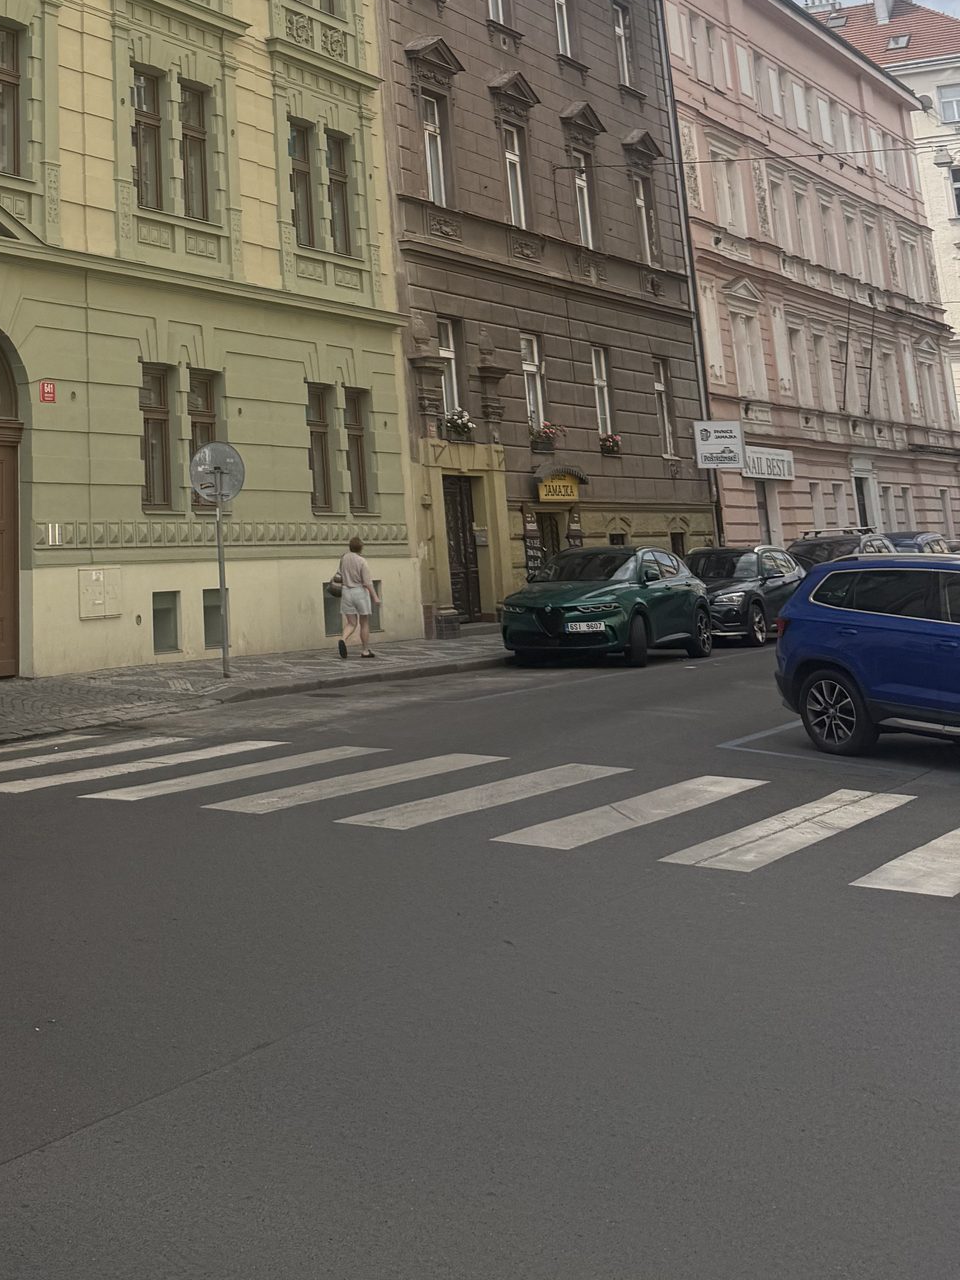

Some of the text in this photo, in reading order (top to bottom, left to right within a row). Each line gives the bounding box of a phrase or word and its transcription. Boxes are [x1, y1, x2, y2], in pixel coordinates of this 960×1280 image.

[745, 455, 786, 477] NAIL BEST
[544, 484, 575, 497] JAMAJKA
